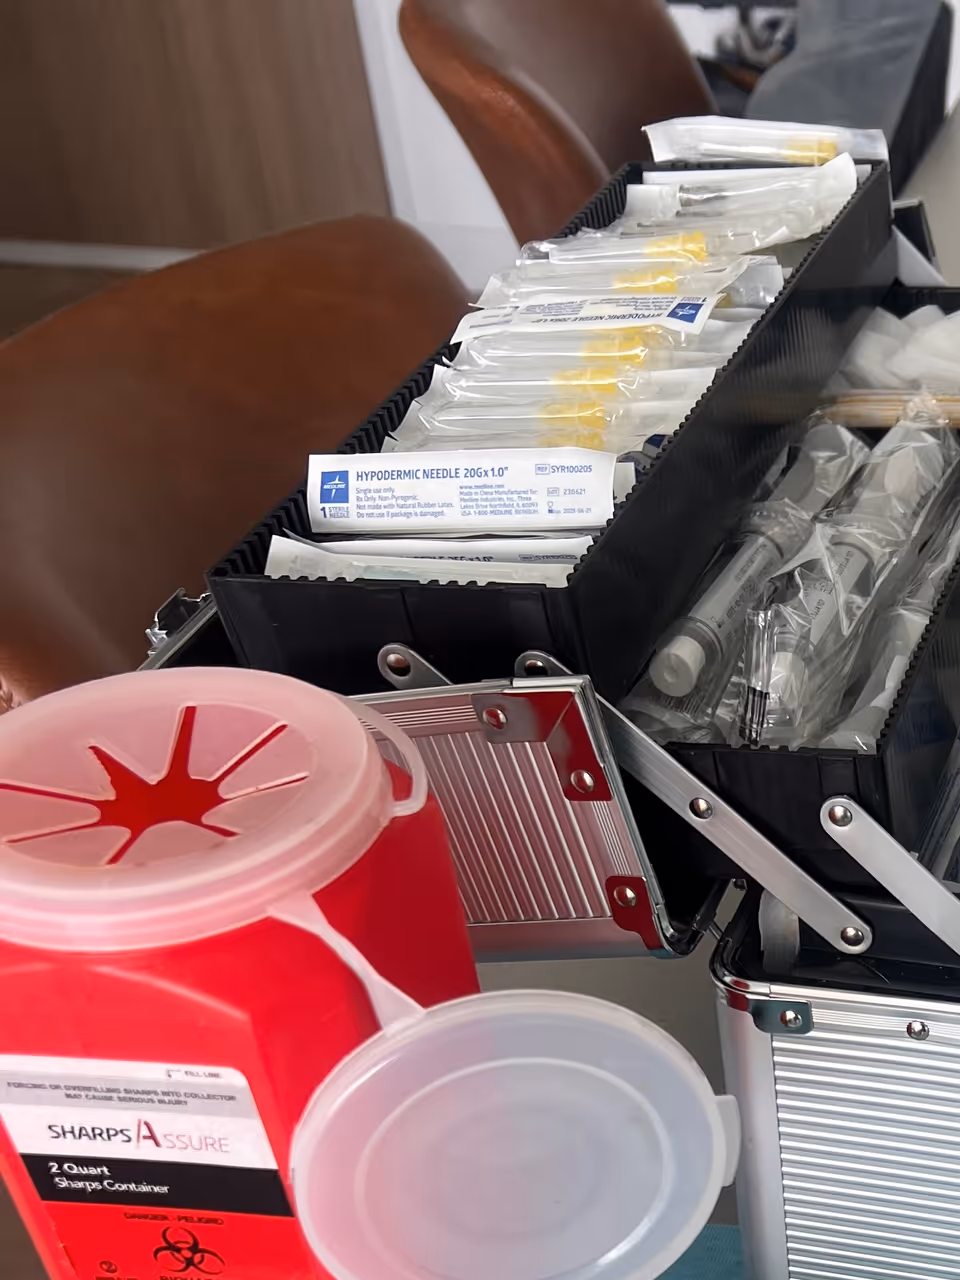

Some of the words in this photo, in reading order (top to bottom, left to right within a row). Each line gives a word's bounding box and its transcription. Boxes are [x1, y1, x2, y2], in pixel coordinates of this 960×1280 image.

[550, 465, 593, 474] SYR100205
[356, 469, 421, 482] HYPODERMIC
[422, 468, 461, 480] NEEDLE
[356, 487, 372, 495] Single
[396, 502, 417, 510] Natural
[320, 507, 327, 518] 1
[391, 511, 413, 519] package
[49, 1162, 61, 1174] 2
[62, 1162, 111, 1177] Quart
[54, 1176, 102, 1193] Sharps
[103, 1179, 170, 1194] Container
